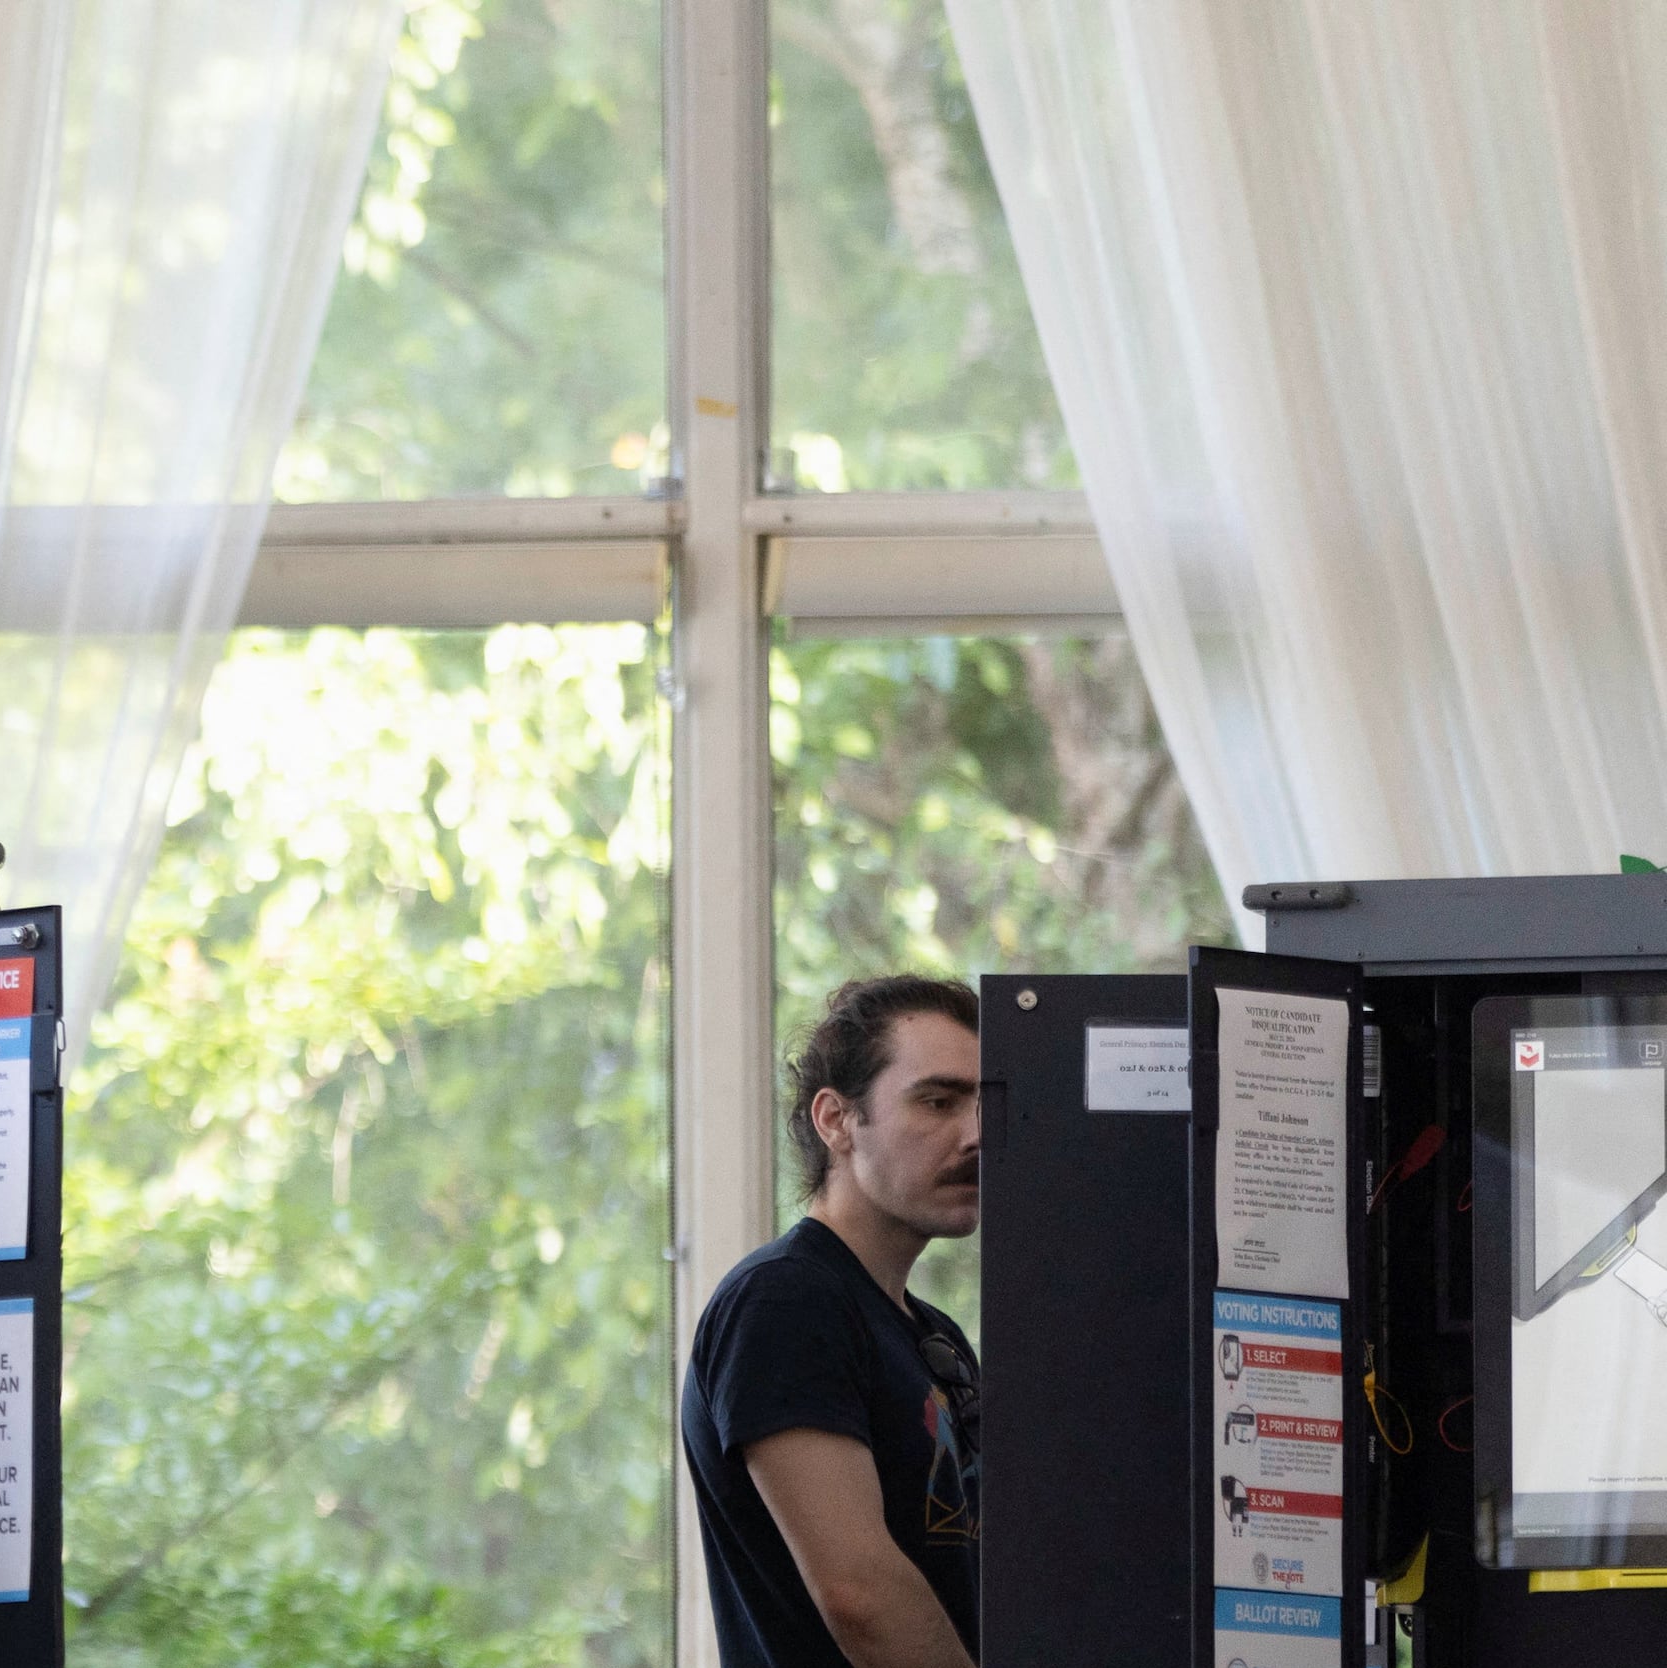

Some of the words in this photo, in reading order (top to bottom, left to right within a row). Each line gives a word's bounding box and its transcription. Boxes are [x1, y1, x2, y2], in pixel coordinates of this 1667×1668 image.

[1245, 1006, 1270, 1018] NOTICE
[1281, 1010, 1322, 1023] CANDIDATE
[1252, 1020, 1315, 1034] DISQUALIFICATION
[1139, 1064, 1145, 1072] &
[1168, 1064, 1176, 1072] &
[1281, 1112, 1309, 1126] Johnson
[1217, 1302, 1259, 1322] VOTING
[1261, 1306, 1338, 1330] INSTRUCTIONS
[1246, 1350, 1253, 1360] 1.
[1253, 1350, 1287, 1364] SELECT
[1261, 1420, 1269, 1431] 2.
[1269, 1420, 1295, 1434] PRINT
[1296, 1423, 1303, 1434] &
[1303, 1424, 1339, 1438] REVIEW
[1251, 1493, 1259, 1505] 3.
[1260, 1494, 1285, 1508] SCAN
[1235, 1603, 1275, 1622] BALLOT
[1279, 1607, 1322, 1627] REVIEW
